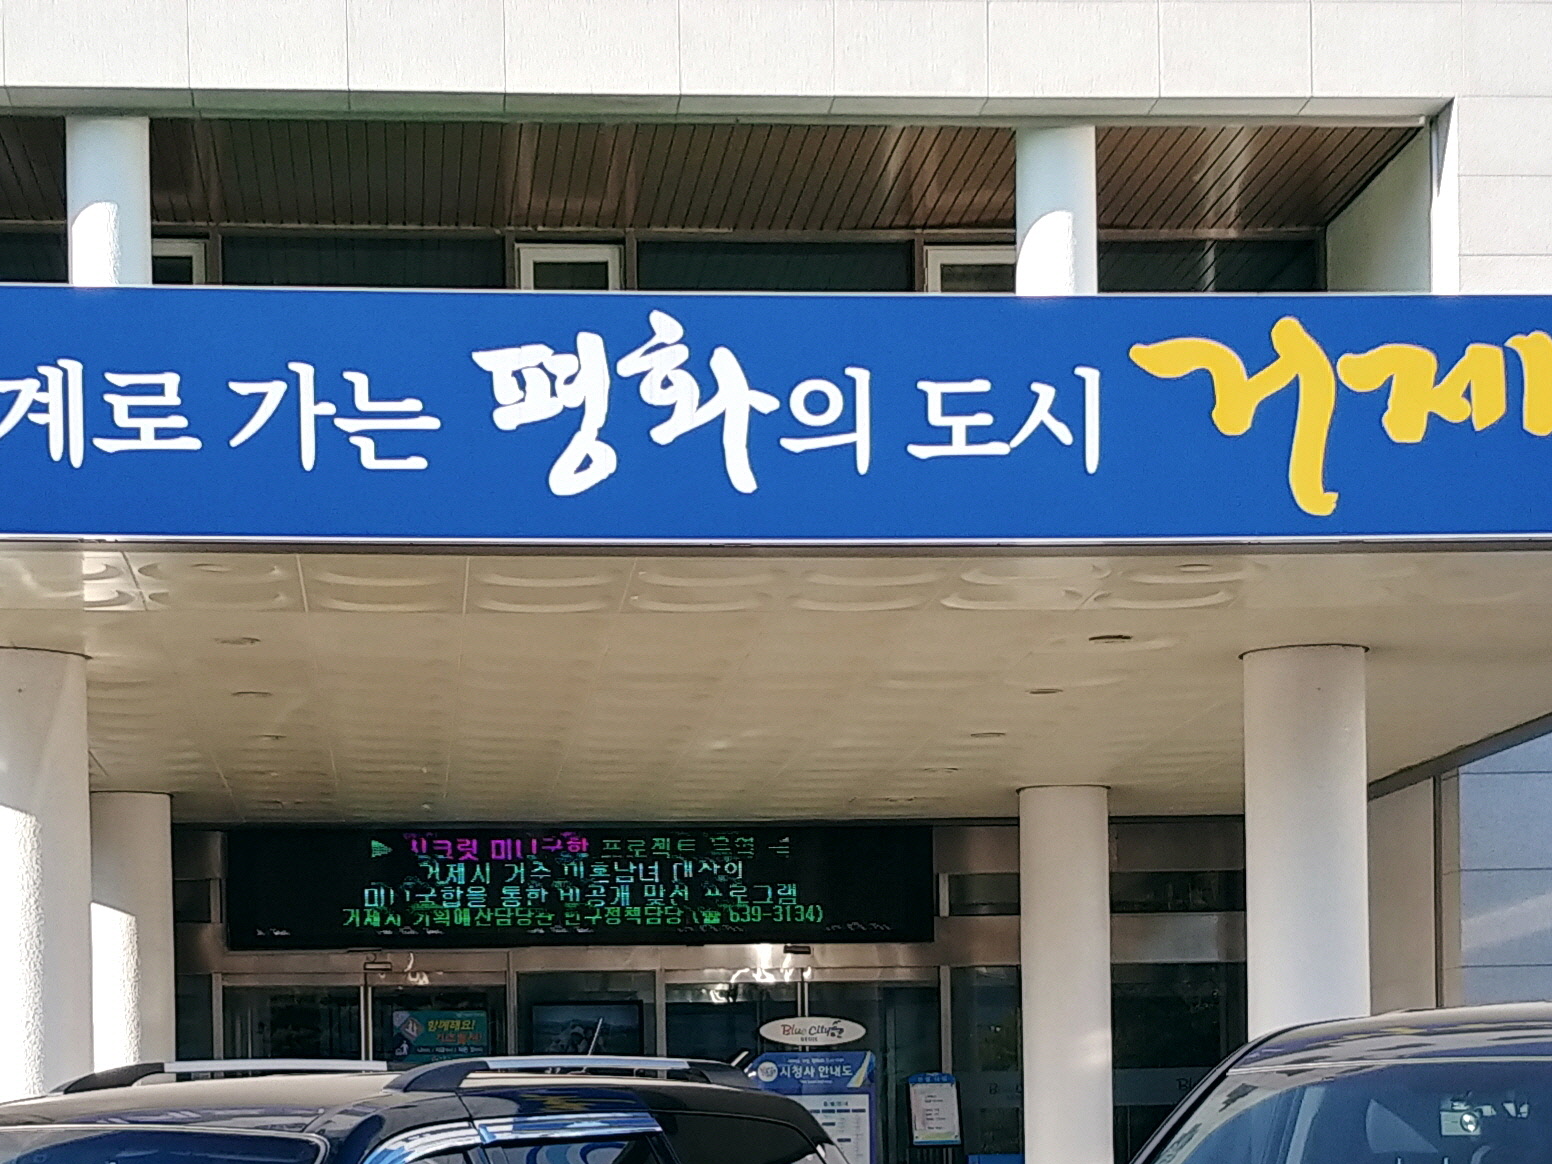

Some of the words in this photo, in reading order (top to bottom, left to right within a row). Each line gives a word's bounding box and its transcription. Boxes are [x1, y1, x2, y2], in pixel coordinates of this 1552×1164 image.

[227, 361, 443, 472] 가는
[471, 309, 871, 497] 평화의
[906, 364, 1101, 474] 도시
[419, 862, 491, 885] 거제시
[504, 861, 552, 883] 거주
[499, 886, 549, 908] 통한
[342, 908, 402, 928] 거제시
[781, 1024, 806, 1036] Blue
[809, 1025, 830, 1037] City
[780, 1065, 815, 1079] 시청사
[818, 1065, 853, 1077] 안내도
